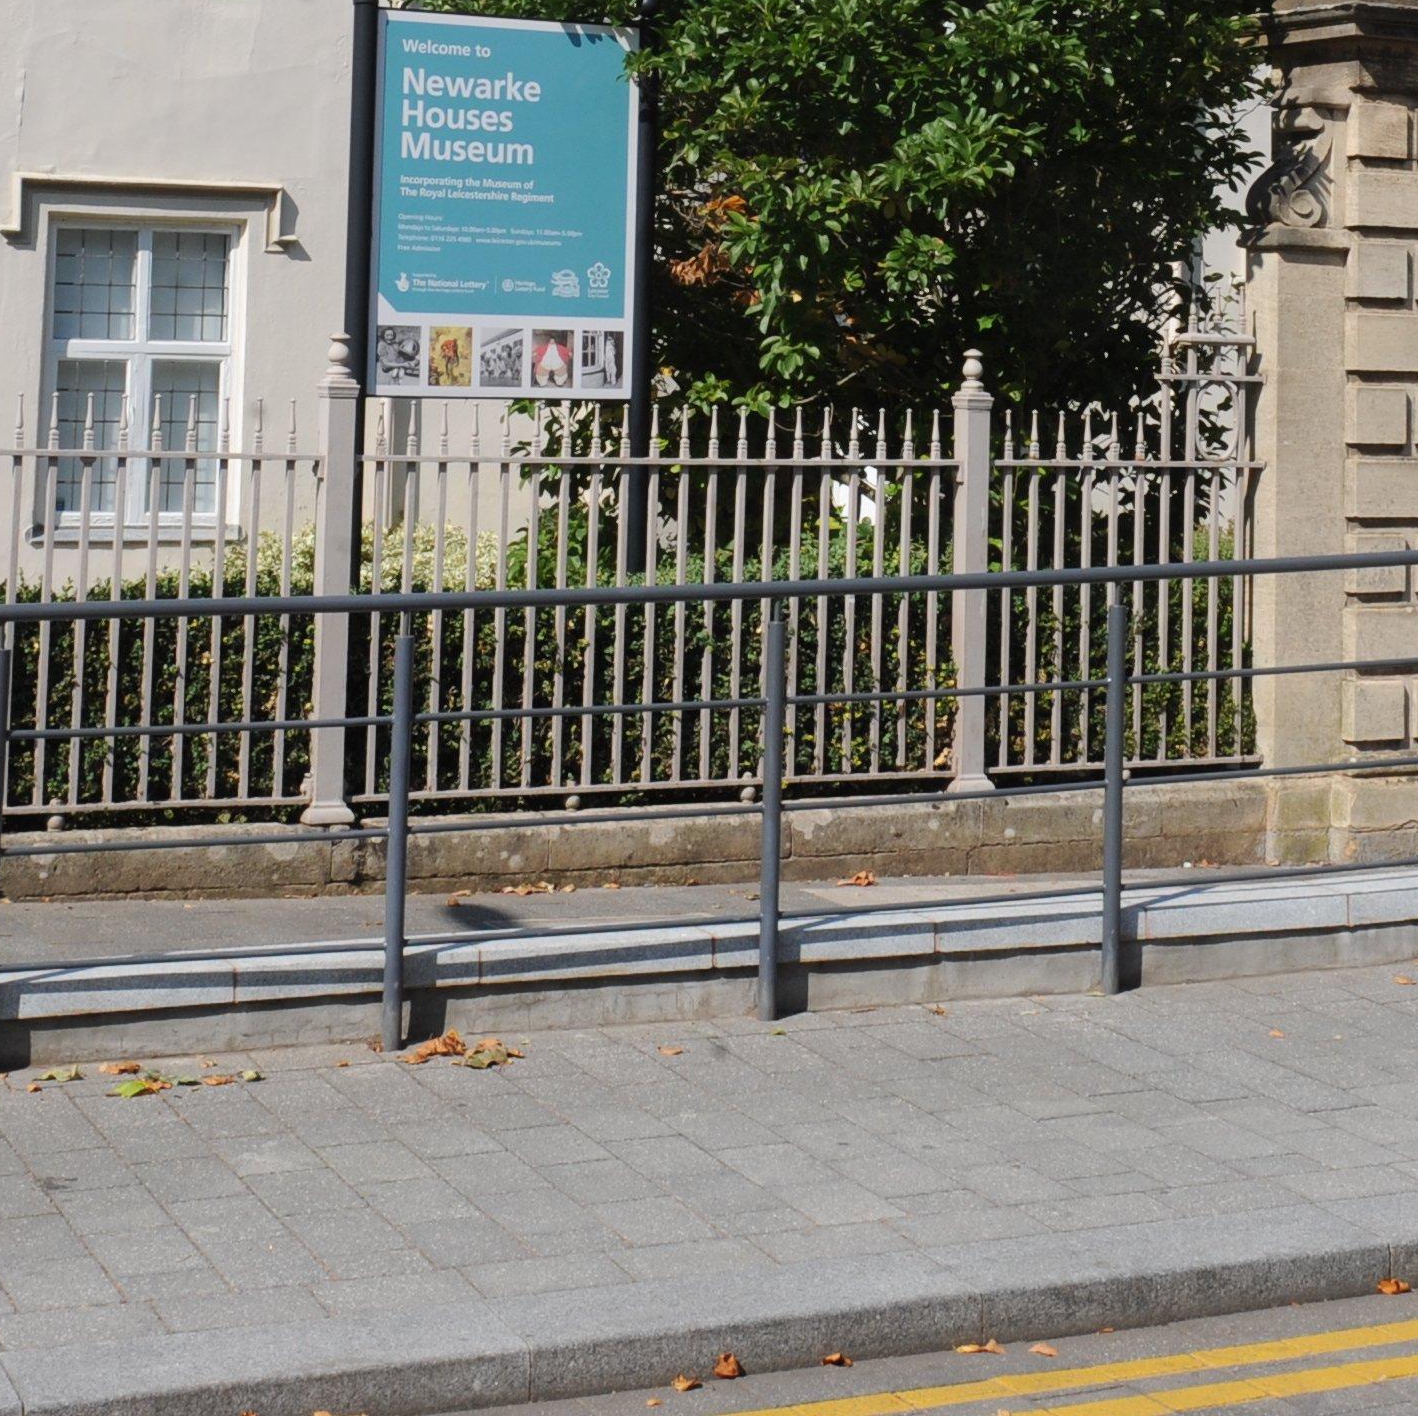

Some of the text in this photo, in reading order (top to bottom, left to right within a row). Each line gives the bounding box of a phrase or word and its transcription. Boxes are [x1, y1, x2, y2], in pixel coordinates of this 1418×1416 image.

[402, 38, 491, 58] Welcome to
[403, 67, 541, 103] Newarke
[402, 99, 513, 133] Houses
[401, 131, 534, 165] Museum
[400, 174, 534, 190] Incorporating the Museum of
[400, 186, 554, 204] The Royal Leicestershire Regiment
[427, 279, 459, 288] National
